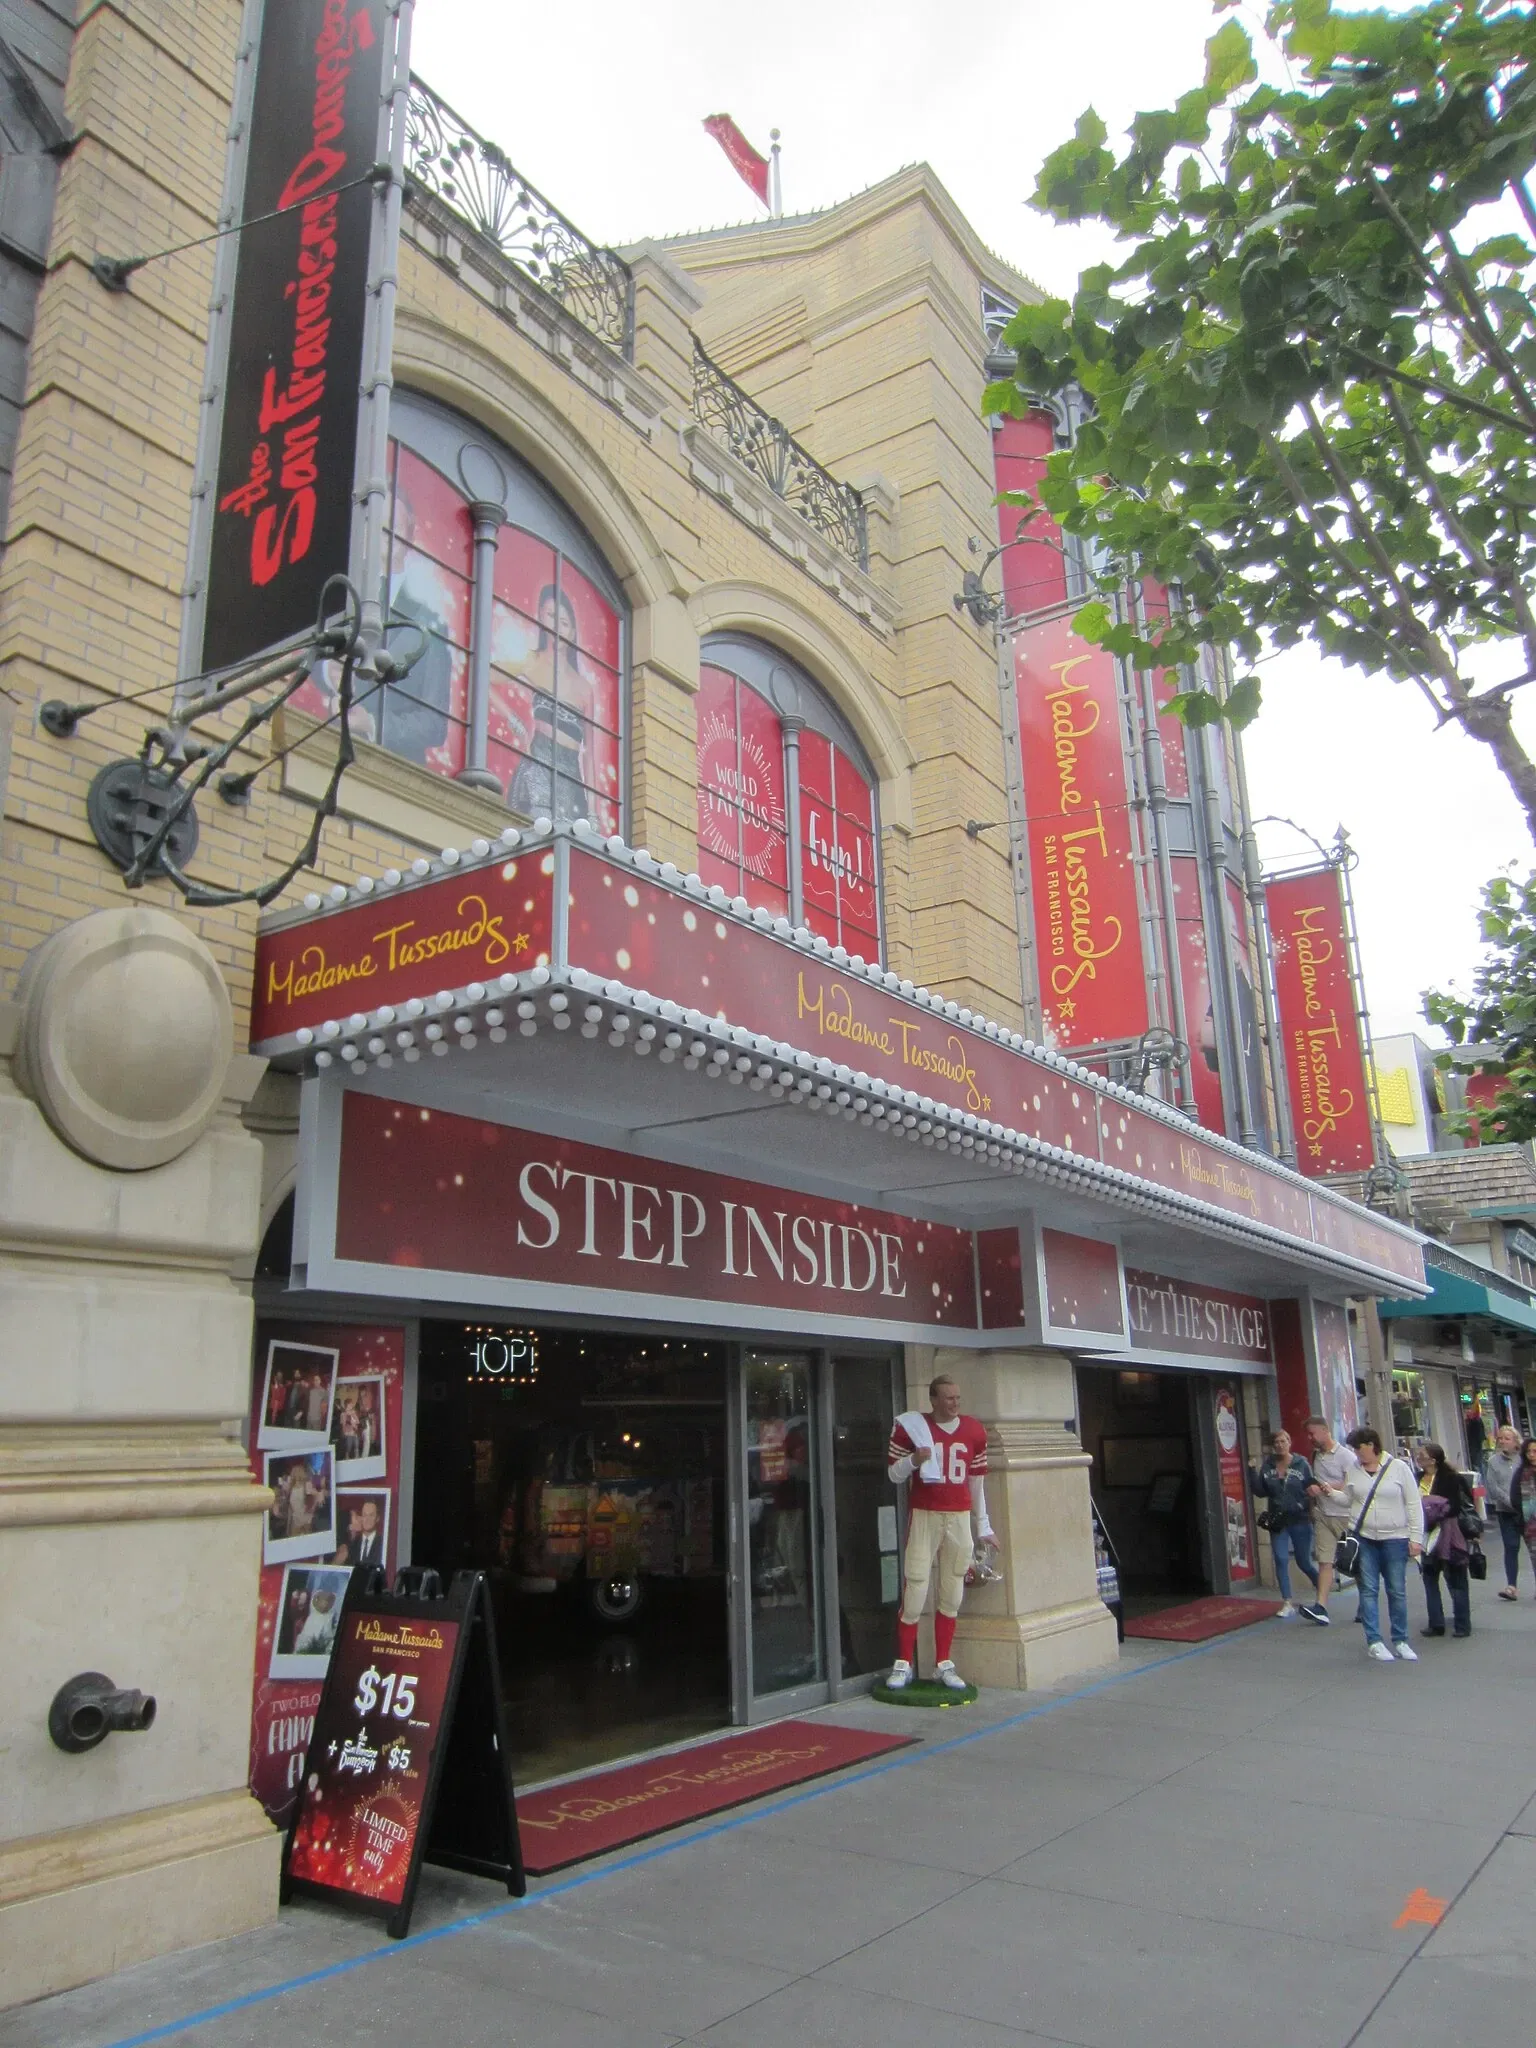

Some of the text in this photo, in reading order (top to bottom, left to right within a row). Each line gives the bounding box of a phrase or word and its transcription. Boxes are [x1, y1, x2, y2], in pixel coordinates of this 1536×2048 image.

[258, 190, 338, 435] Francisco
[220, 442, 272, 517] the
[252, 415, 321, 586] San
[809, 810, 864, 893] Fun!
[1045, 654, 1122, 995] Madame Tussauds
[1044, 835, 1065, 956] SAN FRANCISCO
[267, 895, 510, 1005] Madame Tussauds
[798, 972, 981, 1110] Madame Tussauds
[1292, 906, 1354, 1141] Madame Tussauds
[1295, 1030, 1310, 1114] SAN FRANCISCO
[1180, 1144, 1220, 1188] Madame
[516, 1161, 908, 1298] STEP INSIDE
[1151, 1290, 1203, 1341] THE
[1205, 1300, 1267, 1350] STAGE
[356, 1620, 444, 1649] Madame Tussauds
[372, 1646, 420, 1659] SAN FRANCISCO
[271, 1697, 298, 1713] TWO
[354, 1665, 419, 1718] $15
[388, 1745, 411, 1770] $5
[363, 1808, 408, 1842] LIMITED
[518, 1785, 682, 1830] Madame
[363, 1849, 384, 1875] only
[368, 1828, 394, 1855] TIME
